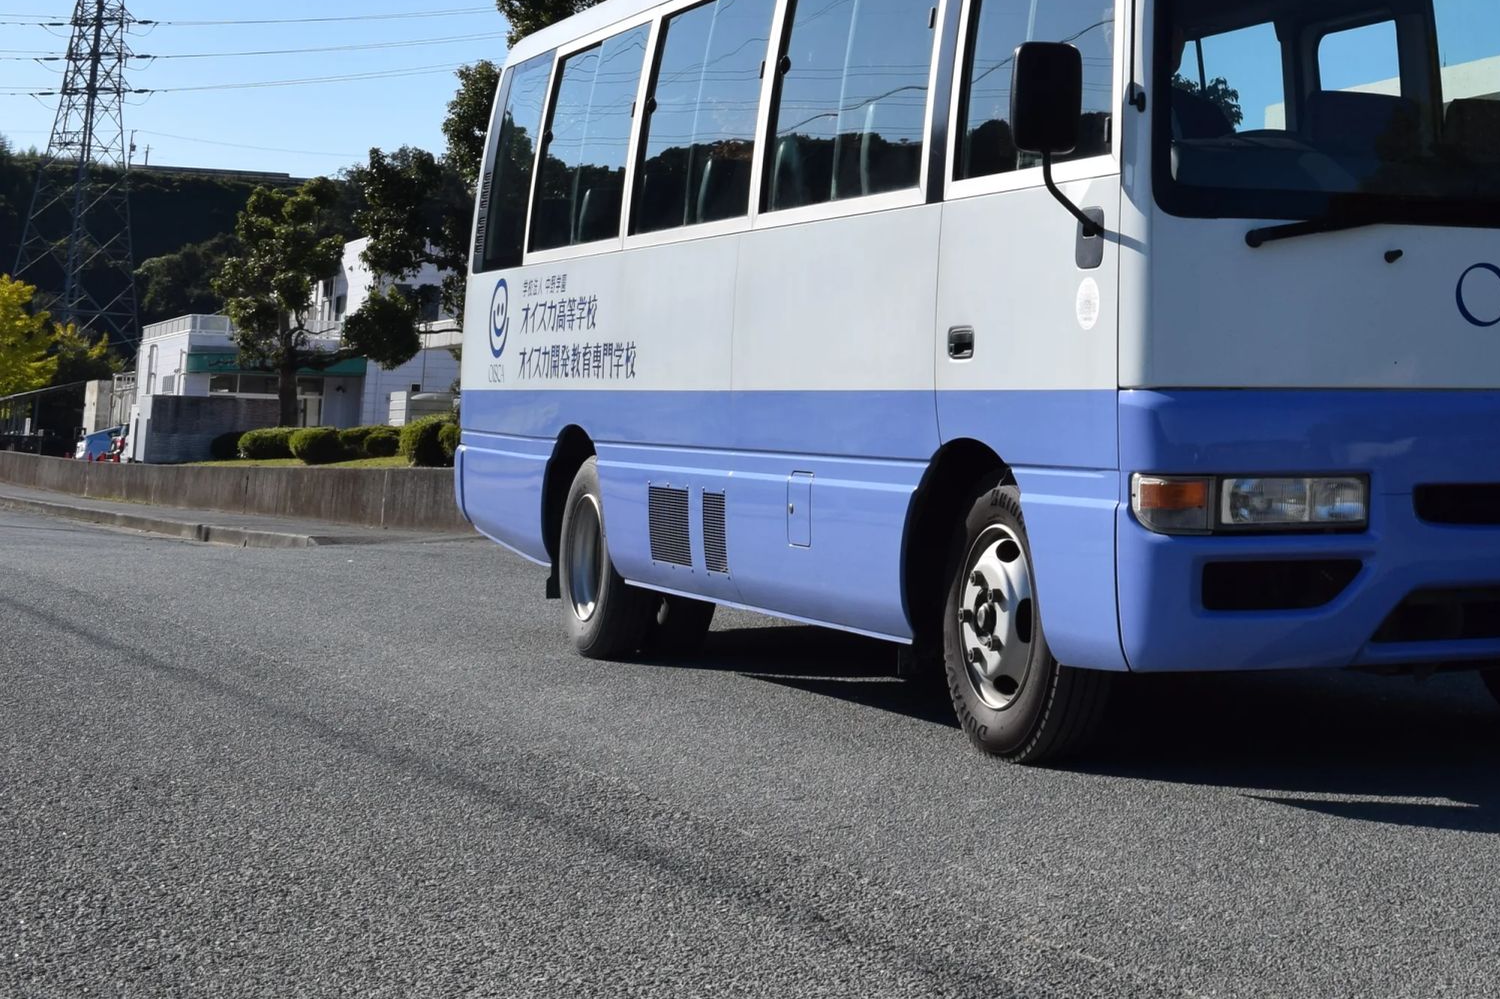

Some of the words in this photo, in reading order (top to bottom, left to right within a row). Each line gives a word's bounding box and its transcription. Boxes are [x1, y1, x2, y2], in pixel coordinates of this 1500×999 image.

[520, 294, 598, 334] オイスカ高等学校
[518, 341, 637, 380] オイスカ開発教育専門学校
